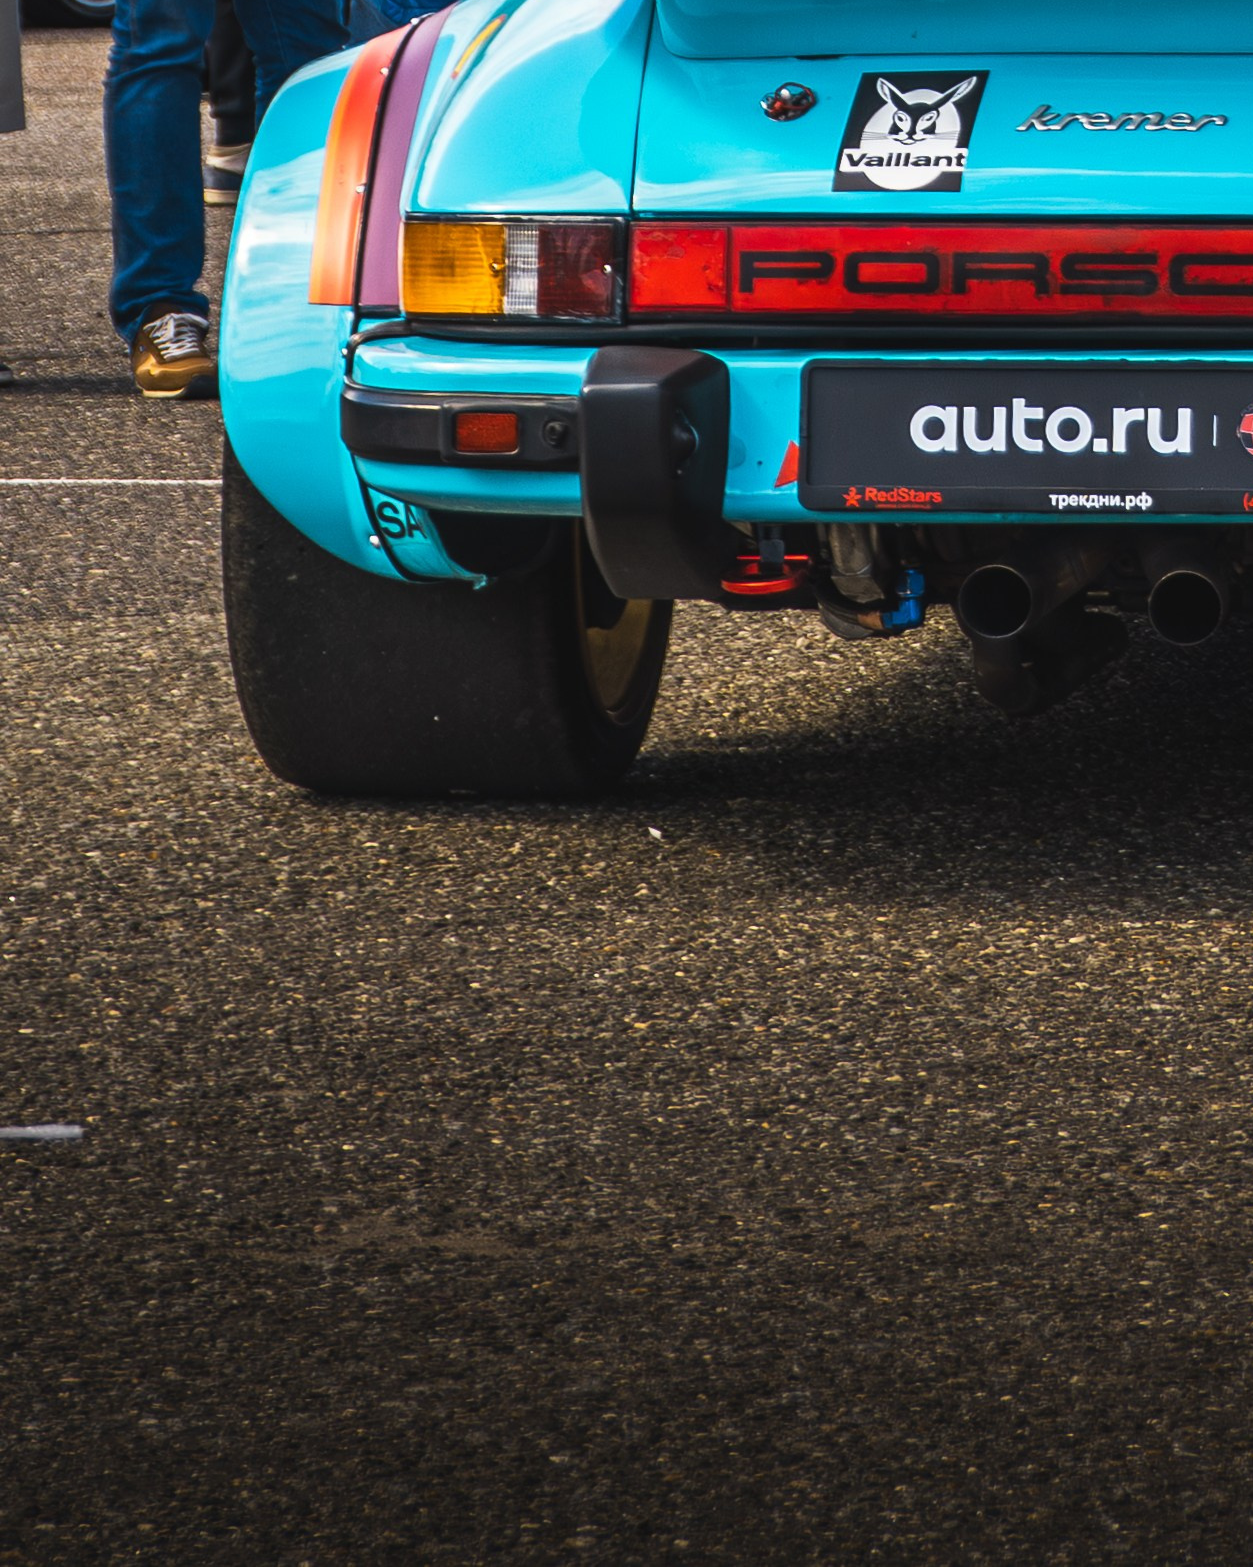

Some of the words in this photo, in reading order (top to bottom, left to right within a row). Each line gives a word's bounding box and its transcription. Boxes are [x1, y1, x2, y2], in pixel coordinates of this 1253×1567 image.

[1015, 103, 1228, 132] kremer
[845, 152, 967, 167] Vaillant
[909, 397, 1193, 454] auto.ru
[864, 486, 942, 504] RedStars
[1048, 491, 1153, 511] трекдни.рф
